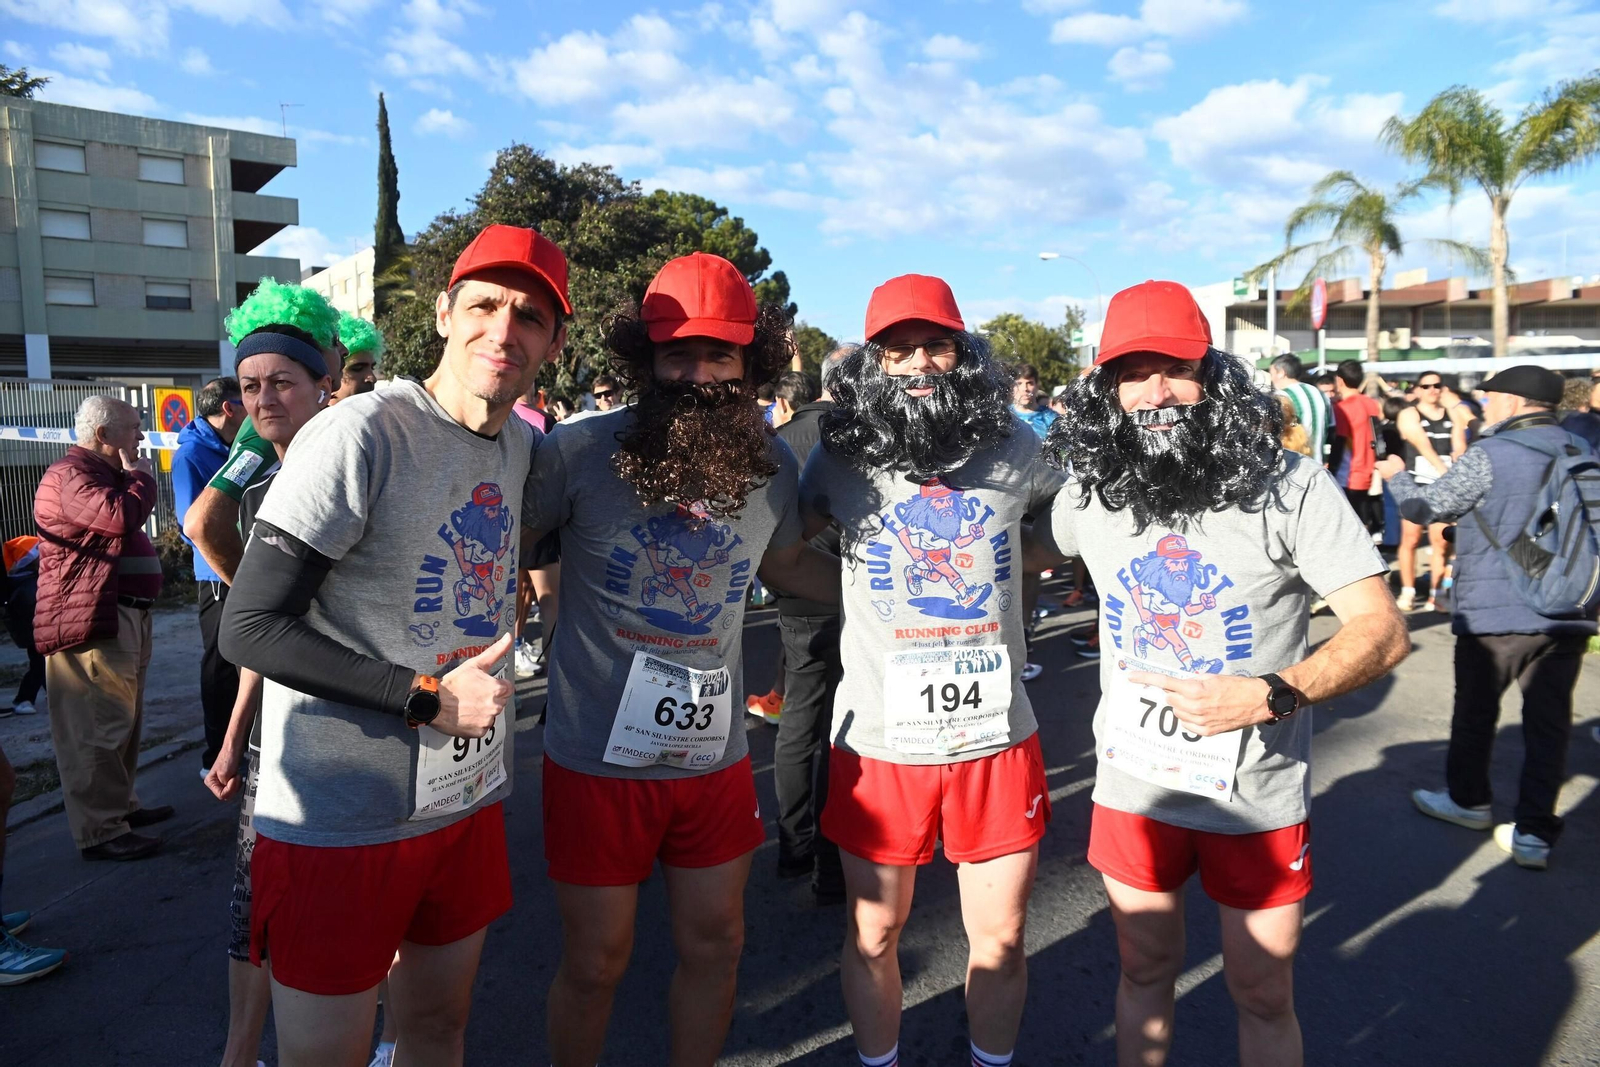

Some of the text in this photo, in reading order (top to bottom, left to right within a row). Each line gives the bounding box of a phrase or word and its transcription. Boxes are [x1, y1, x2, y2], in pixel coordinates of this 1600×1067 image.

[990, 529, 1012, 582] RUN
[605, 546, 638, 595] RUN
[866, 540, 894, 591] RUN
[414, 554, 448, 613] RUN
[725, 558, 750, 603] RUN
[616, 628, 718, 648] RUNNING CLUB
[895, 622, 999, 639] RUNNING CLUB
[1220, 604, 1253, 661] RUN
[702, 671, 721, 685] 2024
[920, 680, 982, 713] 194
[654, 696, 714, 730] 633
[963, 711, 1004, 722] CORDOBESA
[636, 728, 651, 738] SAN
[651, 731, 690, 743] SILVESTRE
[690, 735, 725, 743] CORDOBESA
[650, 740, 668, 748] JAVIER
[900, 737, 935, 745] IMDECO
[622, 747, 655, 760] IMDECO
[696, 753, 712, 761] GCC
[438, 772, 453, 783] SAN
[454, 757, 483, 778] SILVESTRE
[431, 785, 444, 793] JUAN
[430, 792, 461, 811] IMDECO
